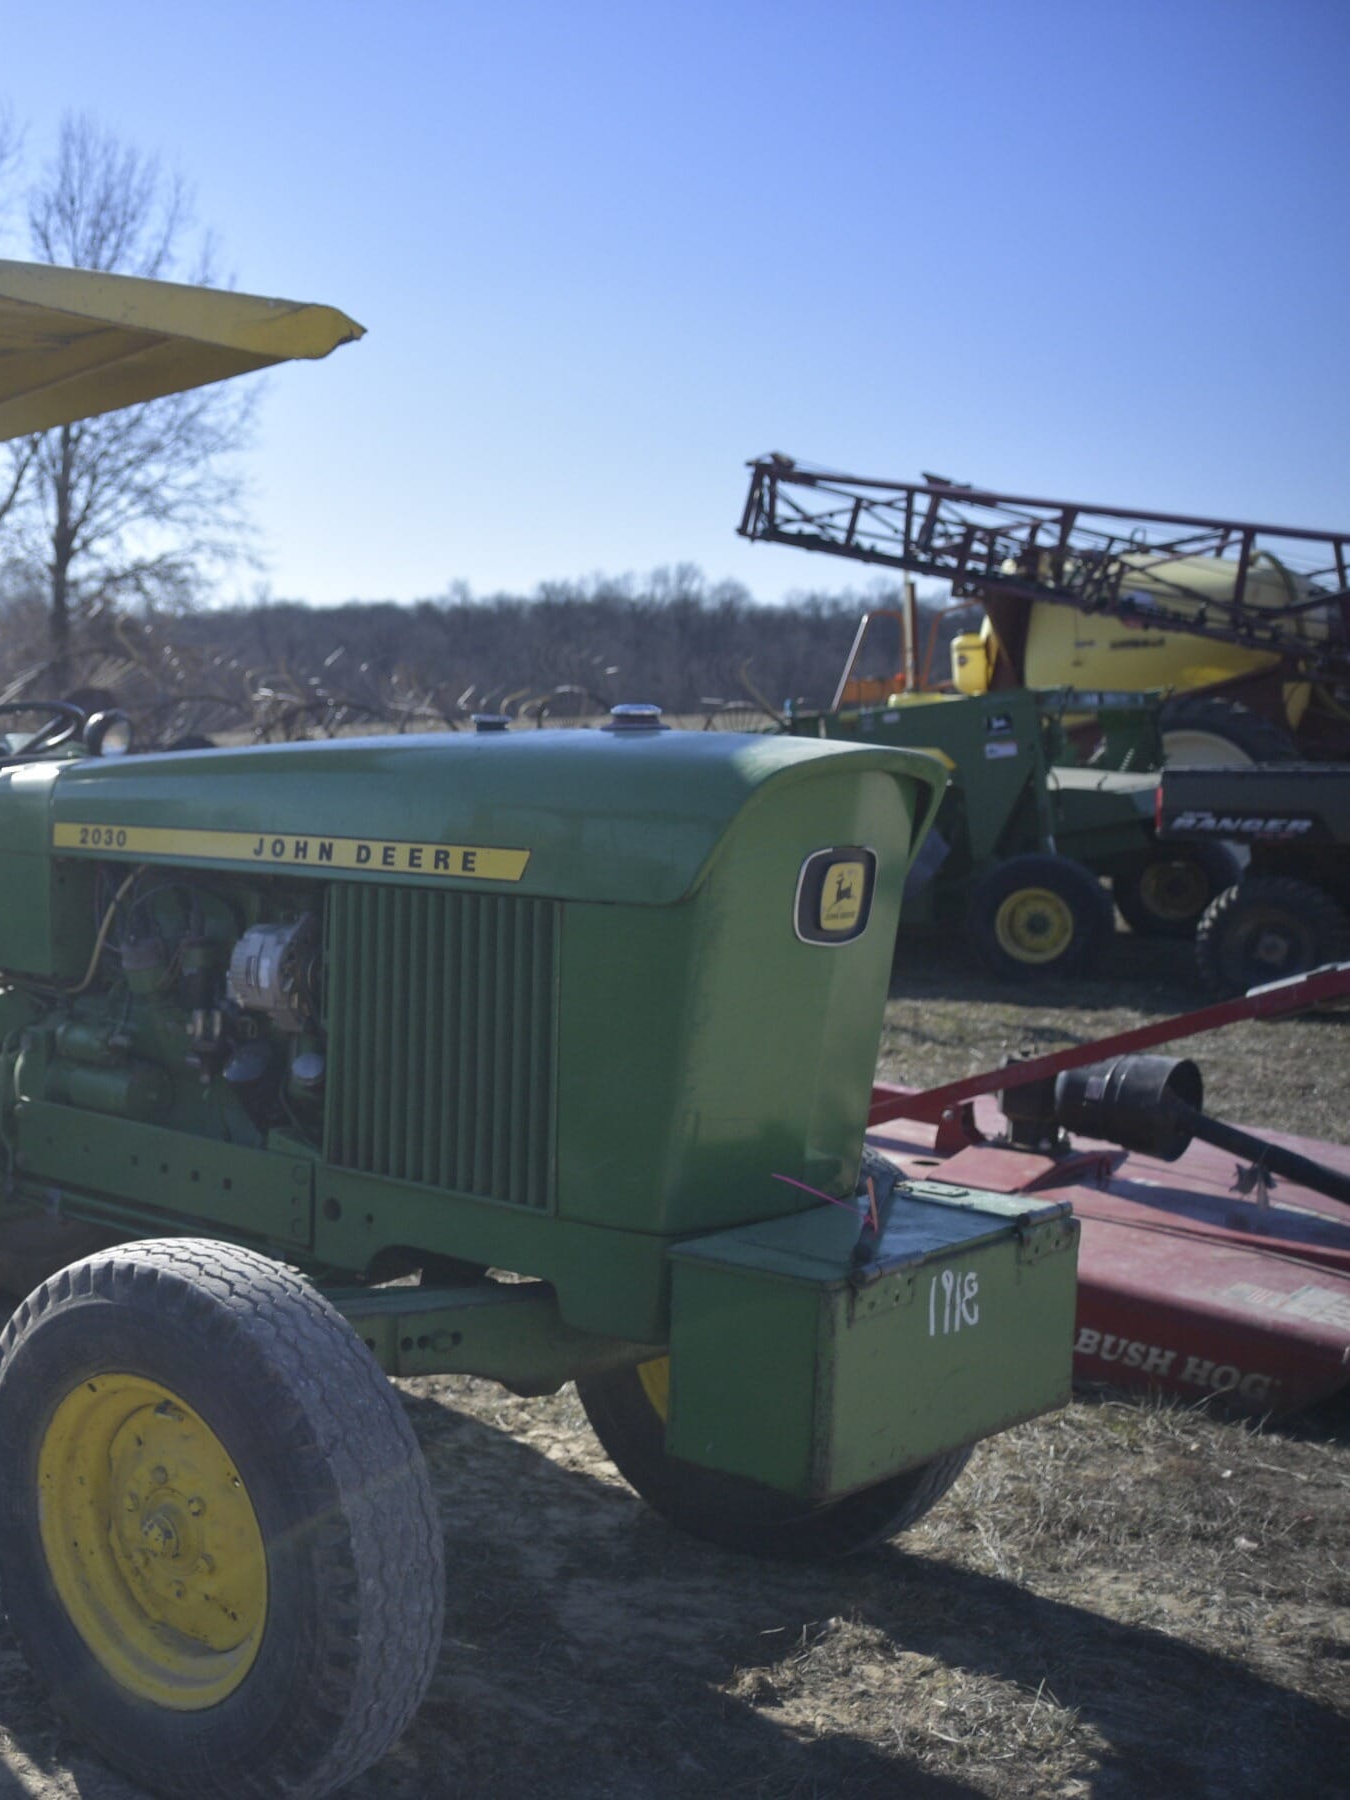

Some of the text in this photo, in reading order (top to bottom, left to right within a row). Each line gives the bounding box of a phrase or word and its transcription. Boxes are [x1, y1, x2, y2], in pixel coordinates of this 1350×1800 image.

[78, 826, 128, 848] 2030
[253, 836, 478, 873] JOHN DEERE
[1074, 1327, 1274, 1402] BUSH HOG
